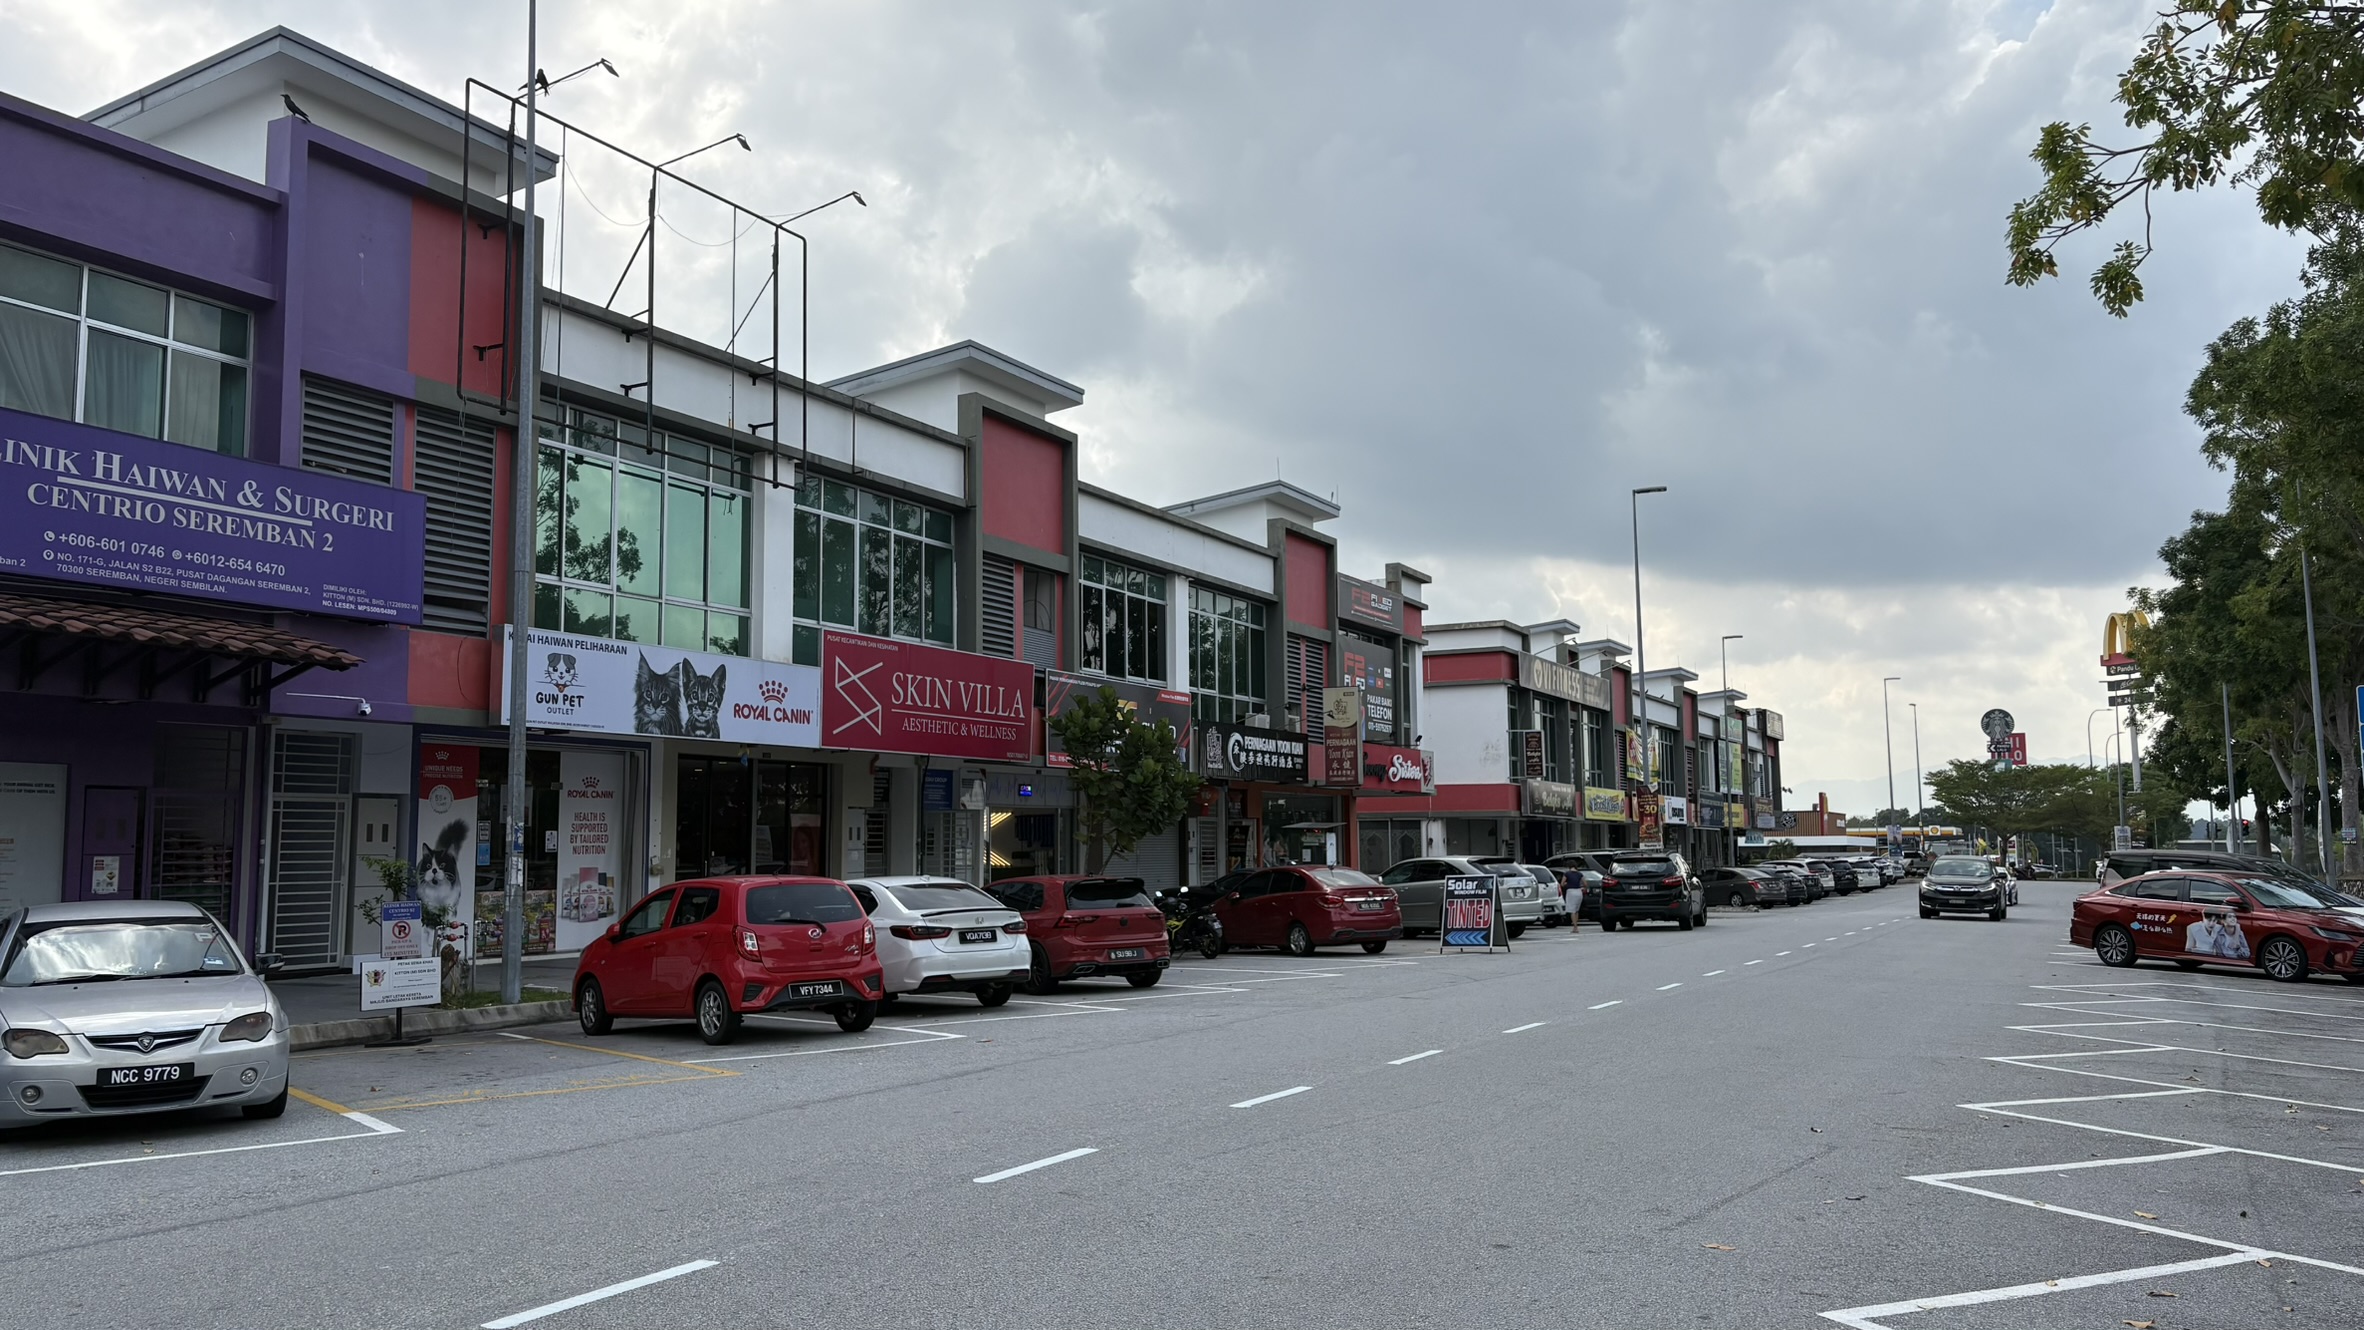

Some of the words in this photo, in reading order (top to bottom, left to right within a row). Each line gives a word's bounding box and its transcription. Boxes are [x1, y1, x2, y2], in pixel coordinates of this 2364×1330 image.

[0, 438, 81, 476] INIK
[92, 450, 227, 502] HAIWAN
[236, 480, 264, 508] &
[274, 486, 394, 532] SURGERI
[27, 482, 166, 525] CENTRIO
[173, 507, 315, 550] SEREMBAN
[322, 532, 334, 552] 2
[59, 532, 126, 553] +606-601
[131, 543, 165, 559] 0746
[185, 550, 253, 572] +6012-654
[256, 562, 286, 576] 6470
[56, 563, 84, 575] 70300
[86, 567, 142, 584] SEREMBAN,
[144, 574, 179, 587] NEGERI
[180, 579, 228, 594] SEMBILAN.
[57, 552, 75, 563] NO.
[78, 554, 106, 568] 171-G,
[108, 559, 140, 572] JALAN
[141, 564, 154, 573] S2
[155, 565, 175, 577] B22,
[176, 568, 206, 580] PUSAT
[207, 572, 256, 587] DAGANGAN
[257, 579, 303, 593] SEREMBAN
[304, 586, 312, 595] 2,
[323, 592, 346, 601] KITTON
[537, 634, 573, 649] HAIWAN
[574, 639, 627, 656] PELIHARAAN
[827, 634, 841, 643] PUSAT
[2117, 665, 2133, 673] Pandu
[535, 692, 559, 706] GUN
[562, 695, 585, 708] PET
[891, 671, 953, 710] SKIN
[958, 681, 1026, 719] VILLA
[546, 706, 574, 716] OUTLET
[734, 702, 771, 722] ROYAL
[774, 707, 811, 724] CANIN
[1367, 704, 1393, 721] TELEFON
[902, 717, 959, 736] AESTHETIC
[960, 722, 968, 736] &
[970, 724, 1017, 741] WELLNESS
[1277, 739, 1291, 754] YOON
[424, 764, 446, 772] UNIQUE
[1388, 754, 1422, 783] Sisters
[567, 789, 589, 799] ROYAL
[590, 790, 613, 799] CANIN
[574, 812, 598, 821] HEALTH
[598, 812, 606, 821] IS
[571, 823, 608, 833] SUPPORTED
[570, 834, 579, 844] BY
[579, 834, 609, 844] TAILORED
[572, 845, 606, 855] NUTRITION
[1446, 898, 1492, 929] TINTED
[111, 1068, 138, 1085] NCC
[143, 1065, 181, 1083] 9779
